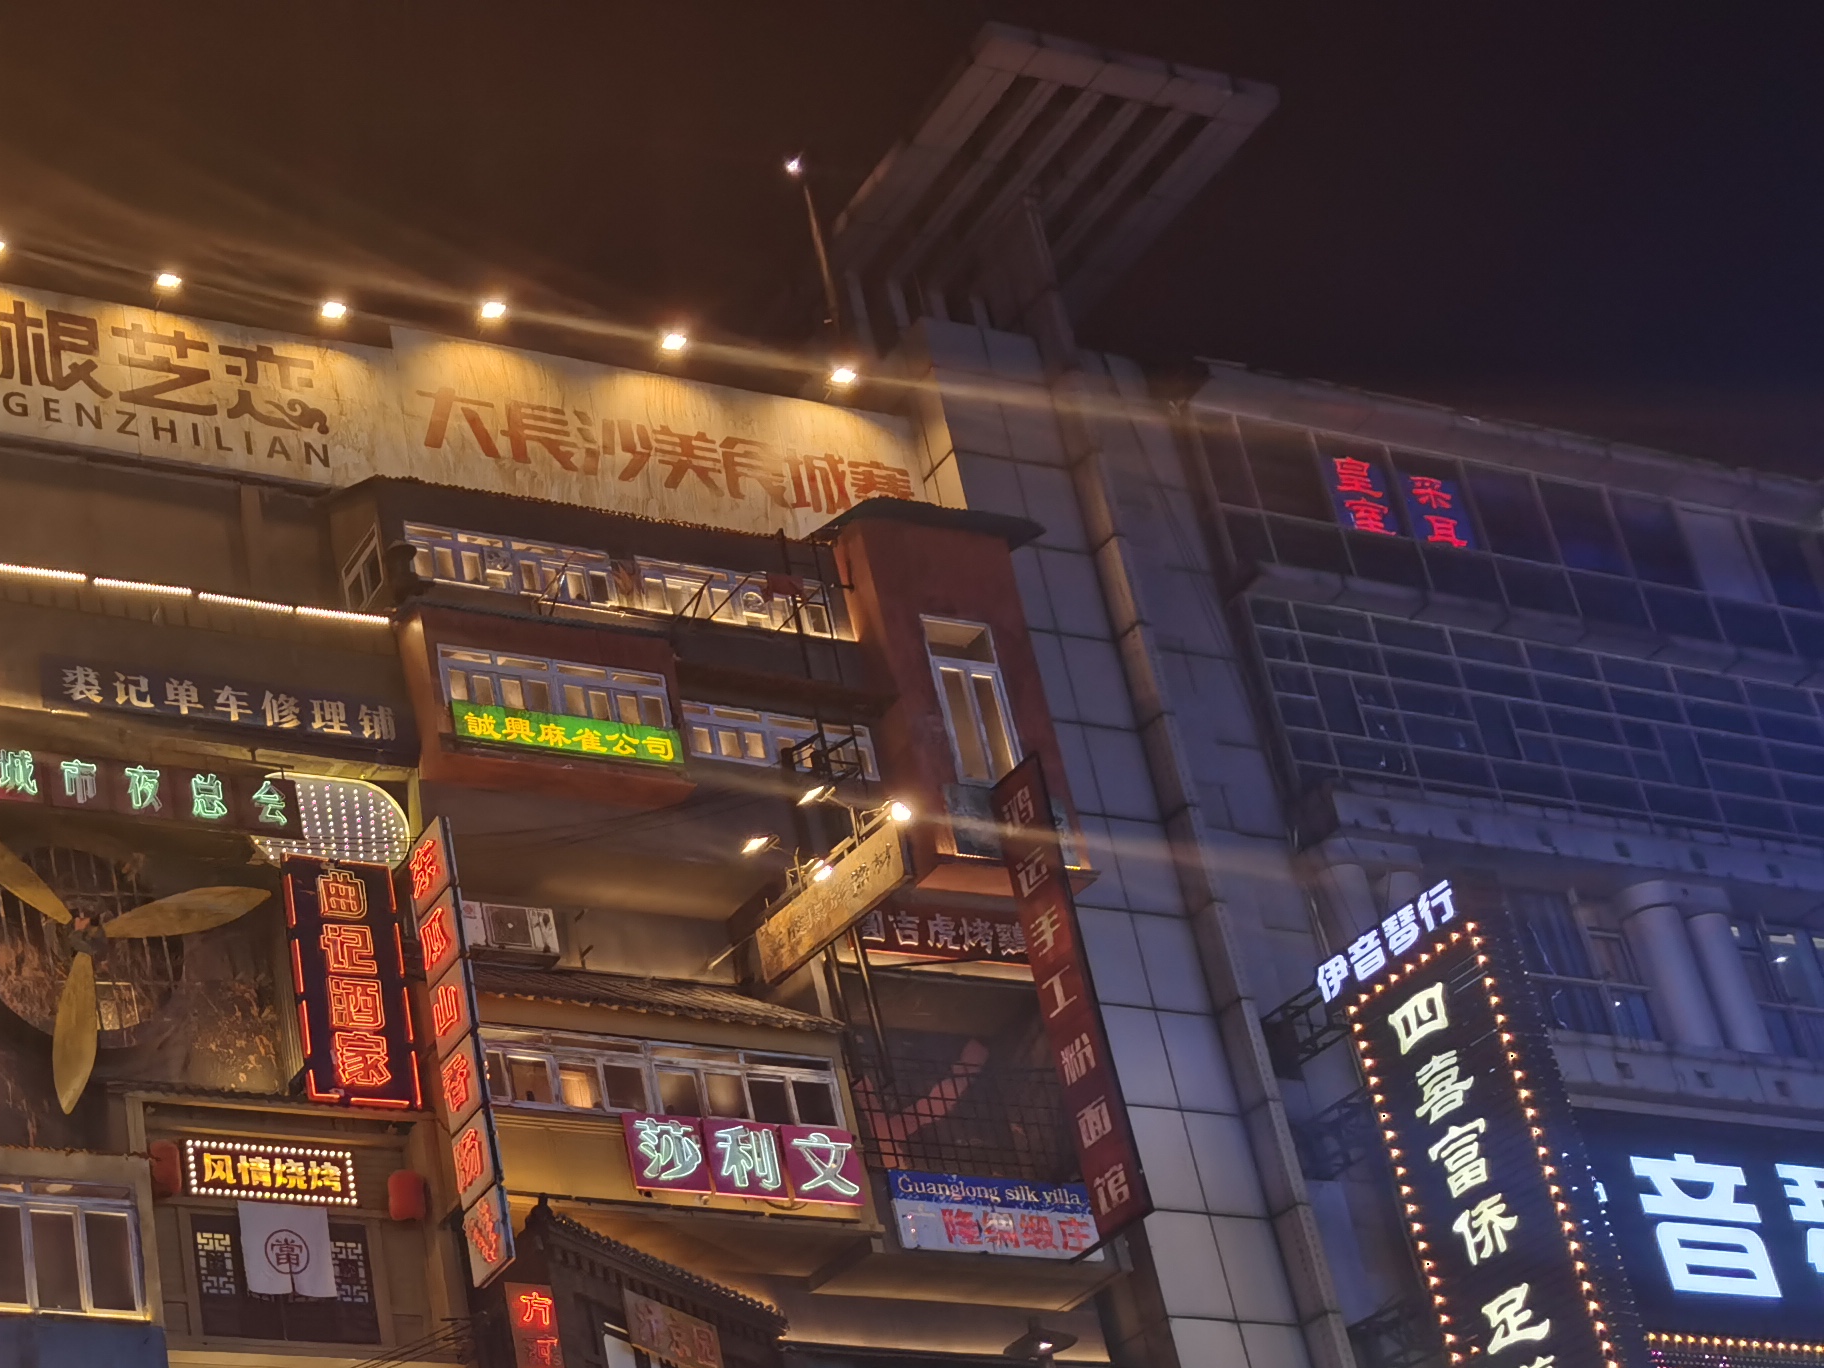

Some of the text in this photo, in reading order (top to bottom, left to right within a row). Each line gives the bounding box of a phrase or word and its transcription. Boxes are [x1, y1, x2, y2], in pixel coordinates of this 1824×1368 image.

[2, 391, 331, 468] GENZHILIAN
[464, 711, 675, 760] 誠興麻雀公司
[317, 869, 392, 1088] 曲记酒家
[1316, 879, 1455, 1004] 伊音琴行
[1002, 787, 1131, 1218] 鸿运手工粉面馆
[202, 1152, 343, 1193] 风情烧烤
[634, 1118, 861, 1198] 莎利文
[1005, 1185, 1041, 1203] silk
